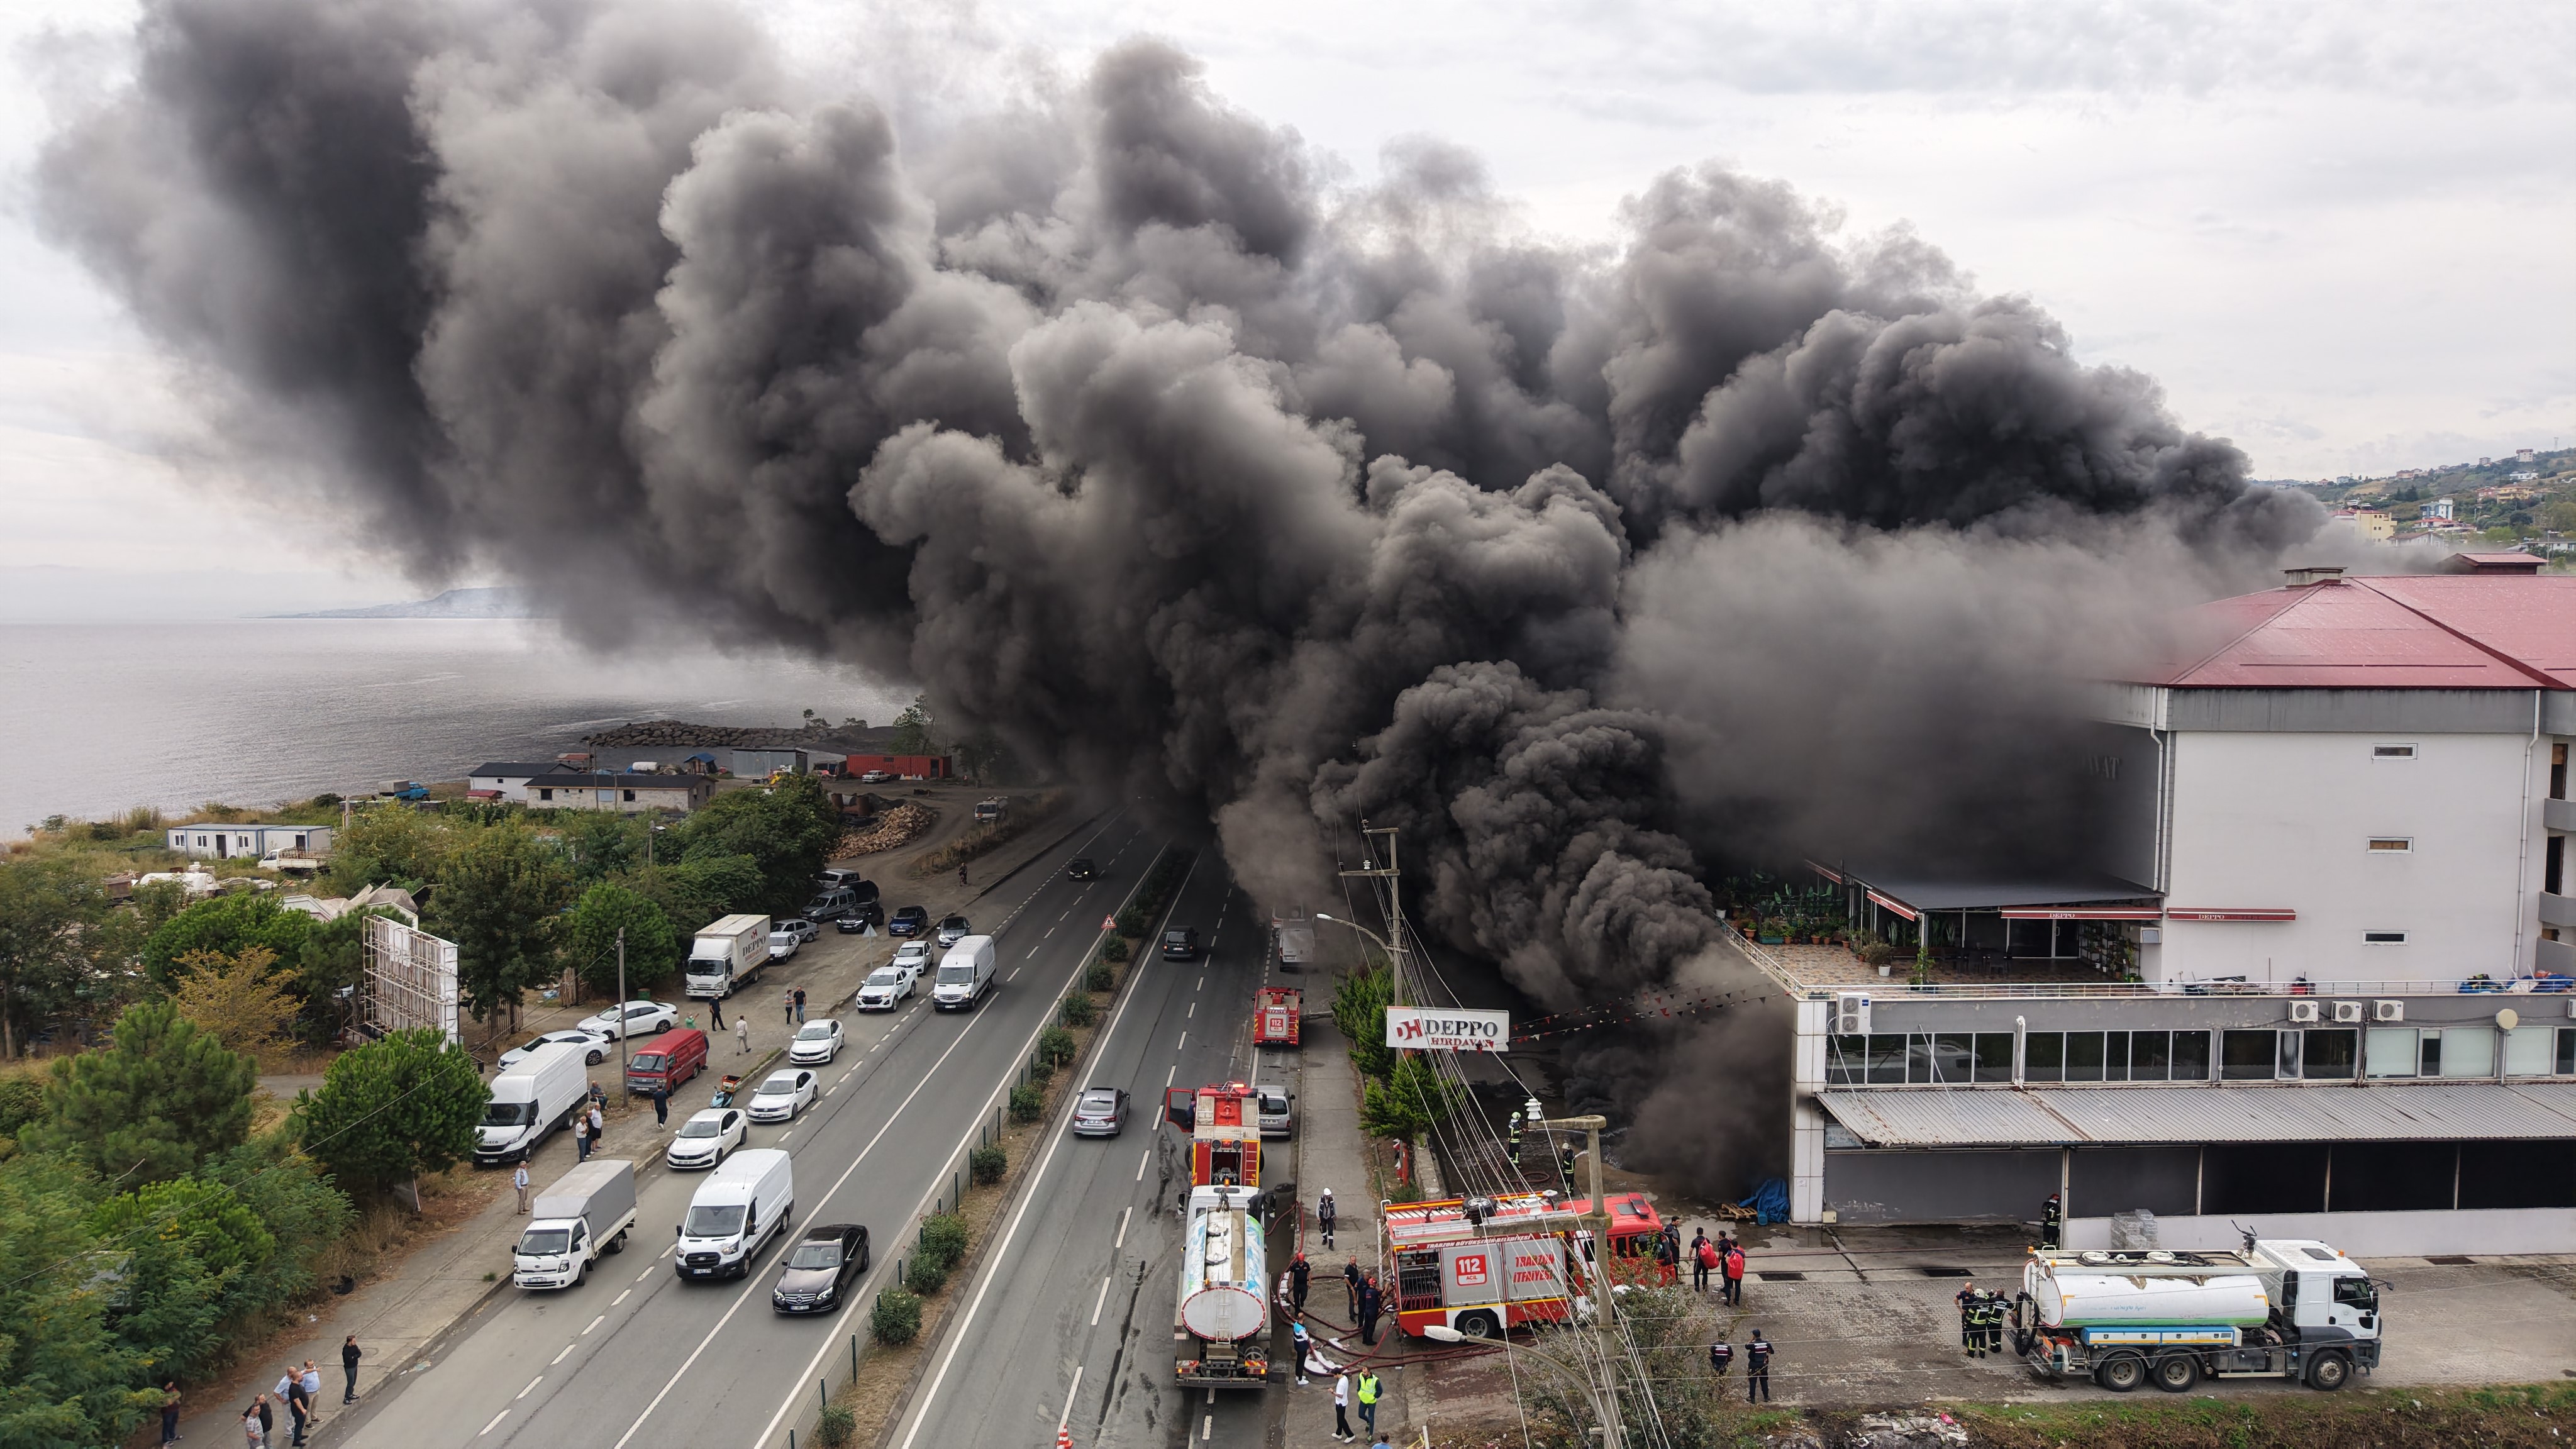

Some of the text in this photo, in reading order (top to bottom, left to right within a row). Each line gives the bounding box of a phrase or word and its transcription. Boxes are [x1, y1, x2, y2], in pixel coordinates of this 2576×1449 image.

[743, 935, 766, 957] DEPPO
[1424, 1019, 1498, 1037] DEPPO
[1458, 1258, 1481, 1274] 112
